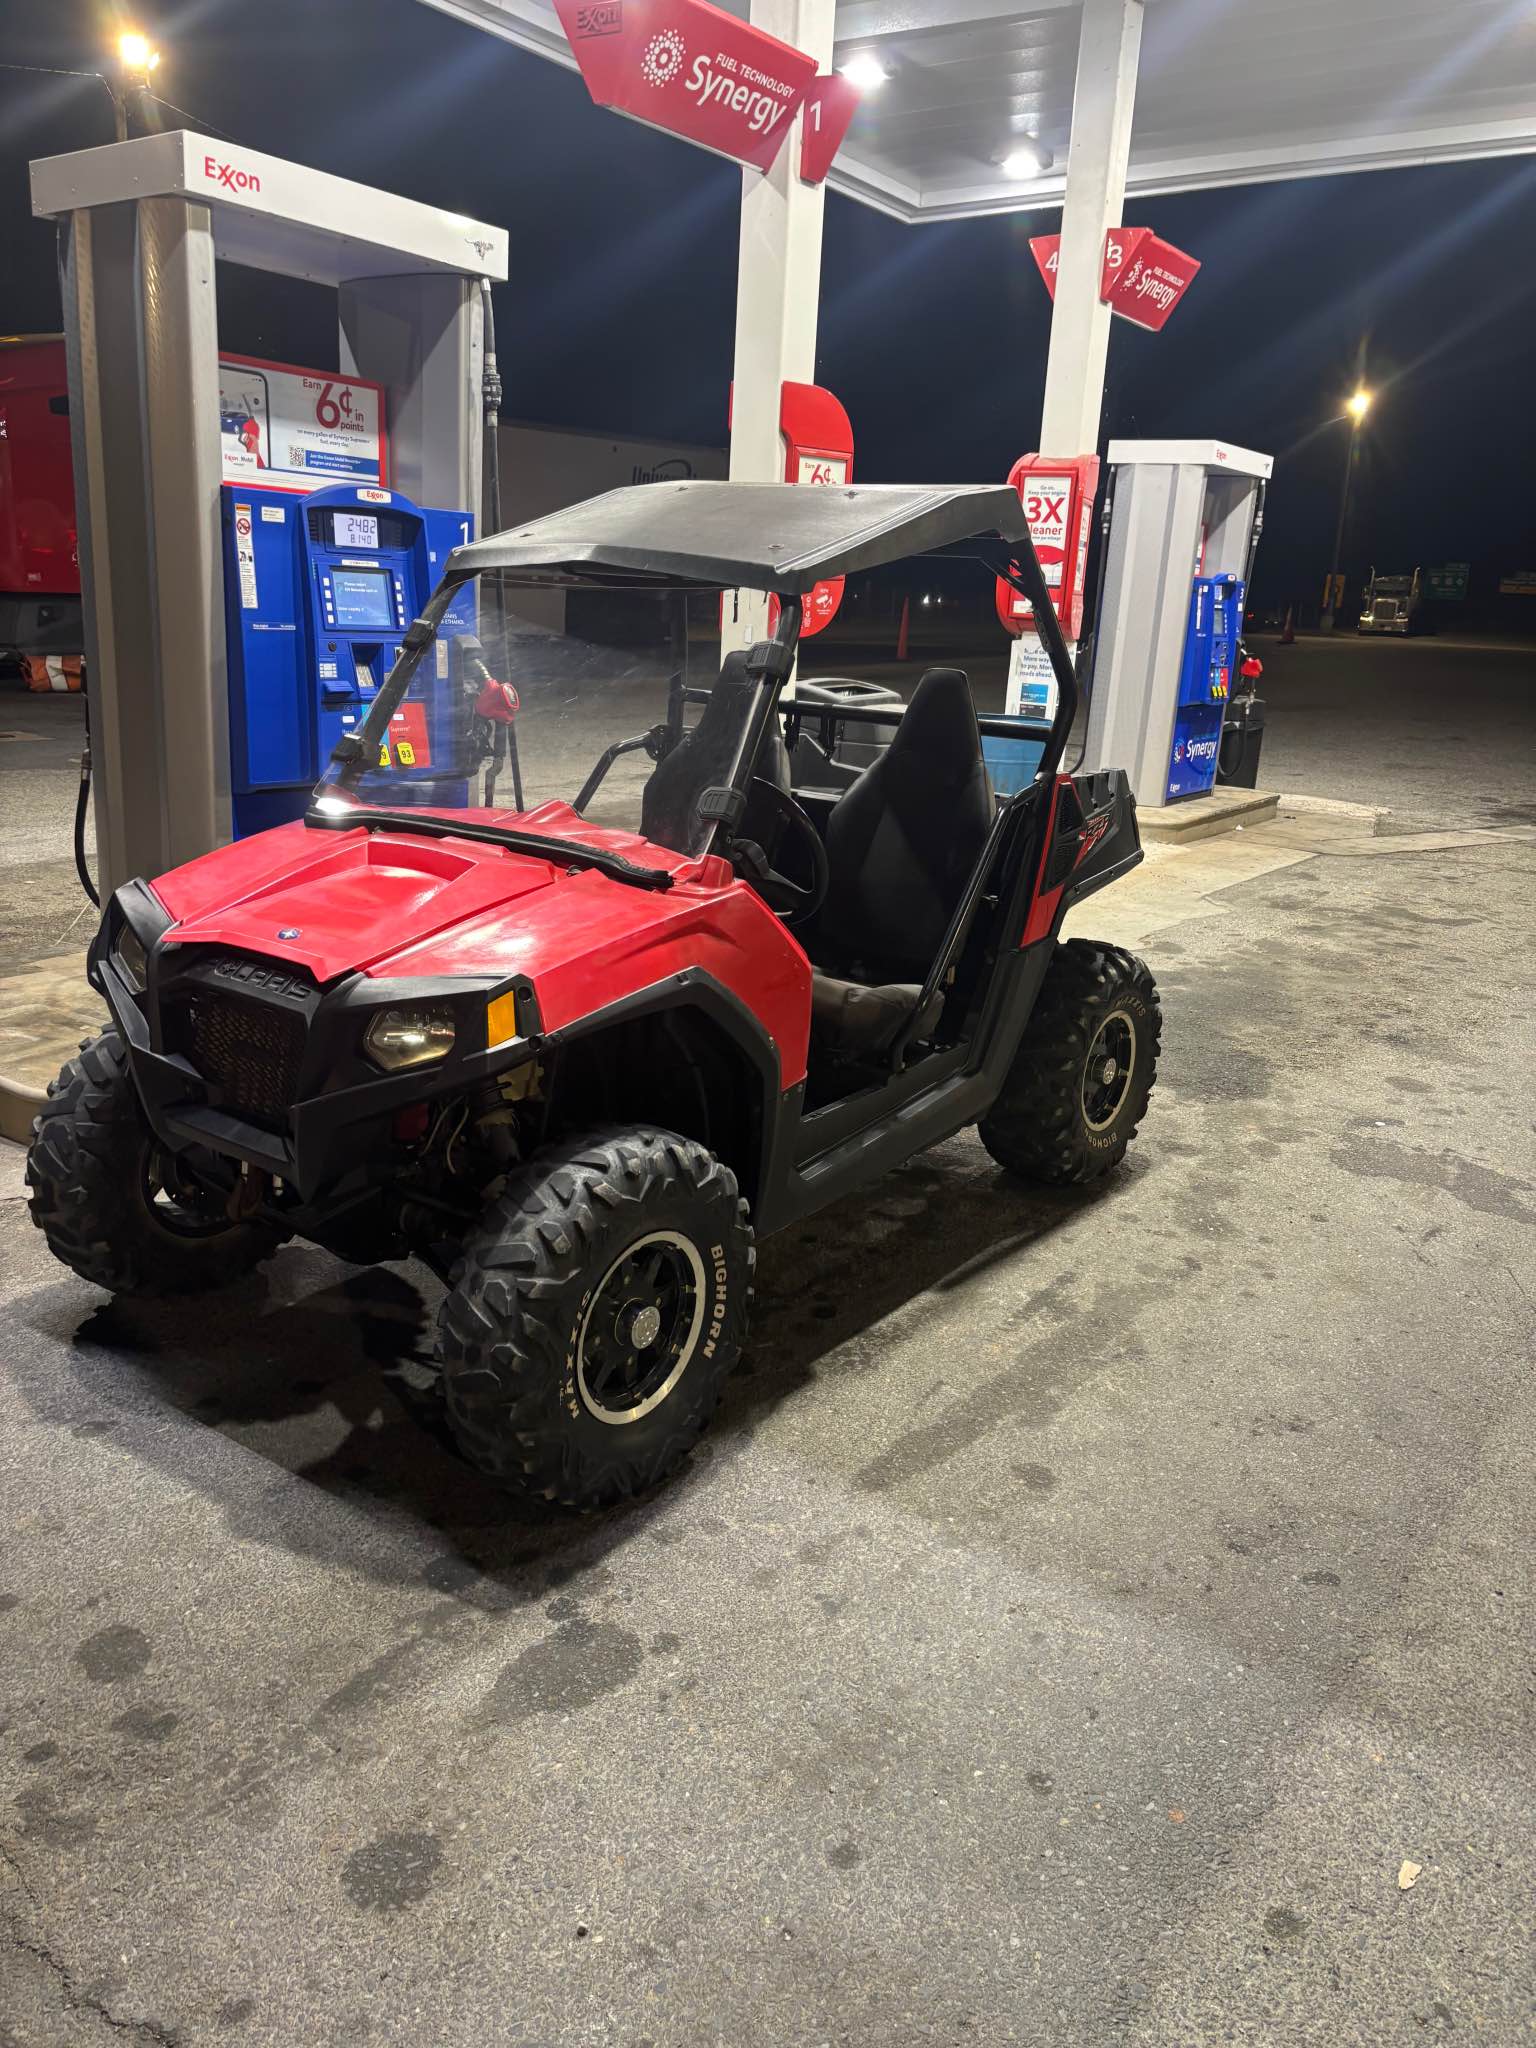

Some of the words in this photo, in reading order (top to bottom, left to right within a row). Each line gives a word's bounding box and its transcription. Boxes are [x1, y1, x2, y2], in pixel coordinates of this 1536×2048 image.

[715, 52, 737, 73] FUEL
[740, 63, 796, 99] TECHNOLOGY
[684, 55, 788, 135] Synergy
[810, 100, 821, 131] 1
[204, 156, 260, 193] Exxon
[1045, 251, 1059, 273] 4
[1109, 245, 1123, 267] 3
[1136, 269, 1178, 310] Synergy
[303, 378, 321, 390] Earn
[355, 409, 364, 421] in
[340, 421, 364, 432] points
[366, 490, 384, 500] Exxon
[1026, 496, 1065, 524] 3X
[460, 522, 469, 545] 1
[1030, 524, 1063, 536] leaner
[401, 750, 411, 758] 93
[1186, 740, 1217, 762] Synergy
[703, 1243, 728, 1360] BIGHORN
